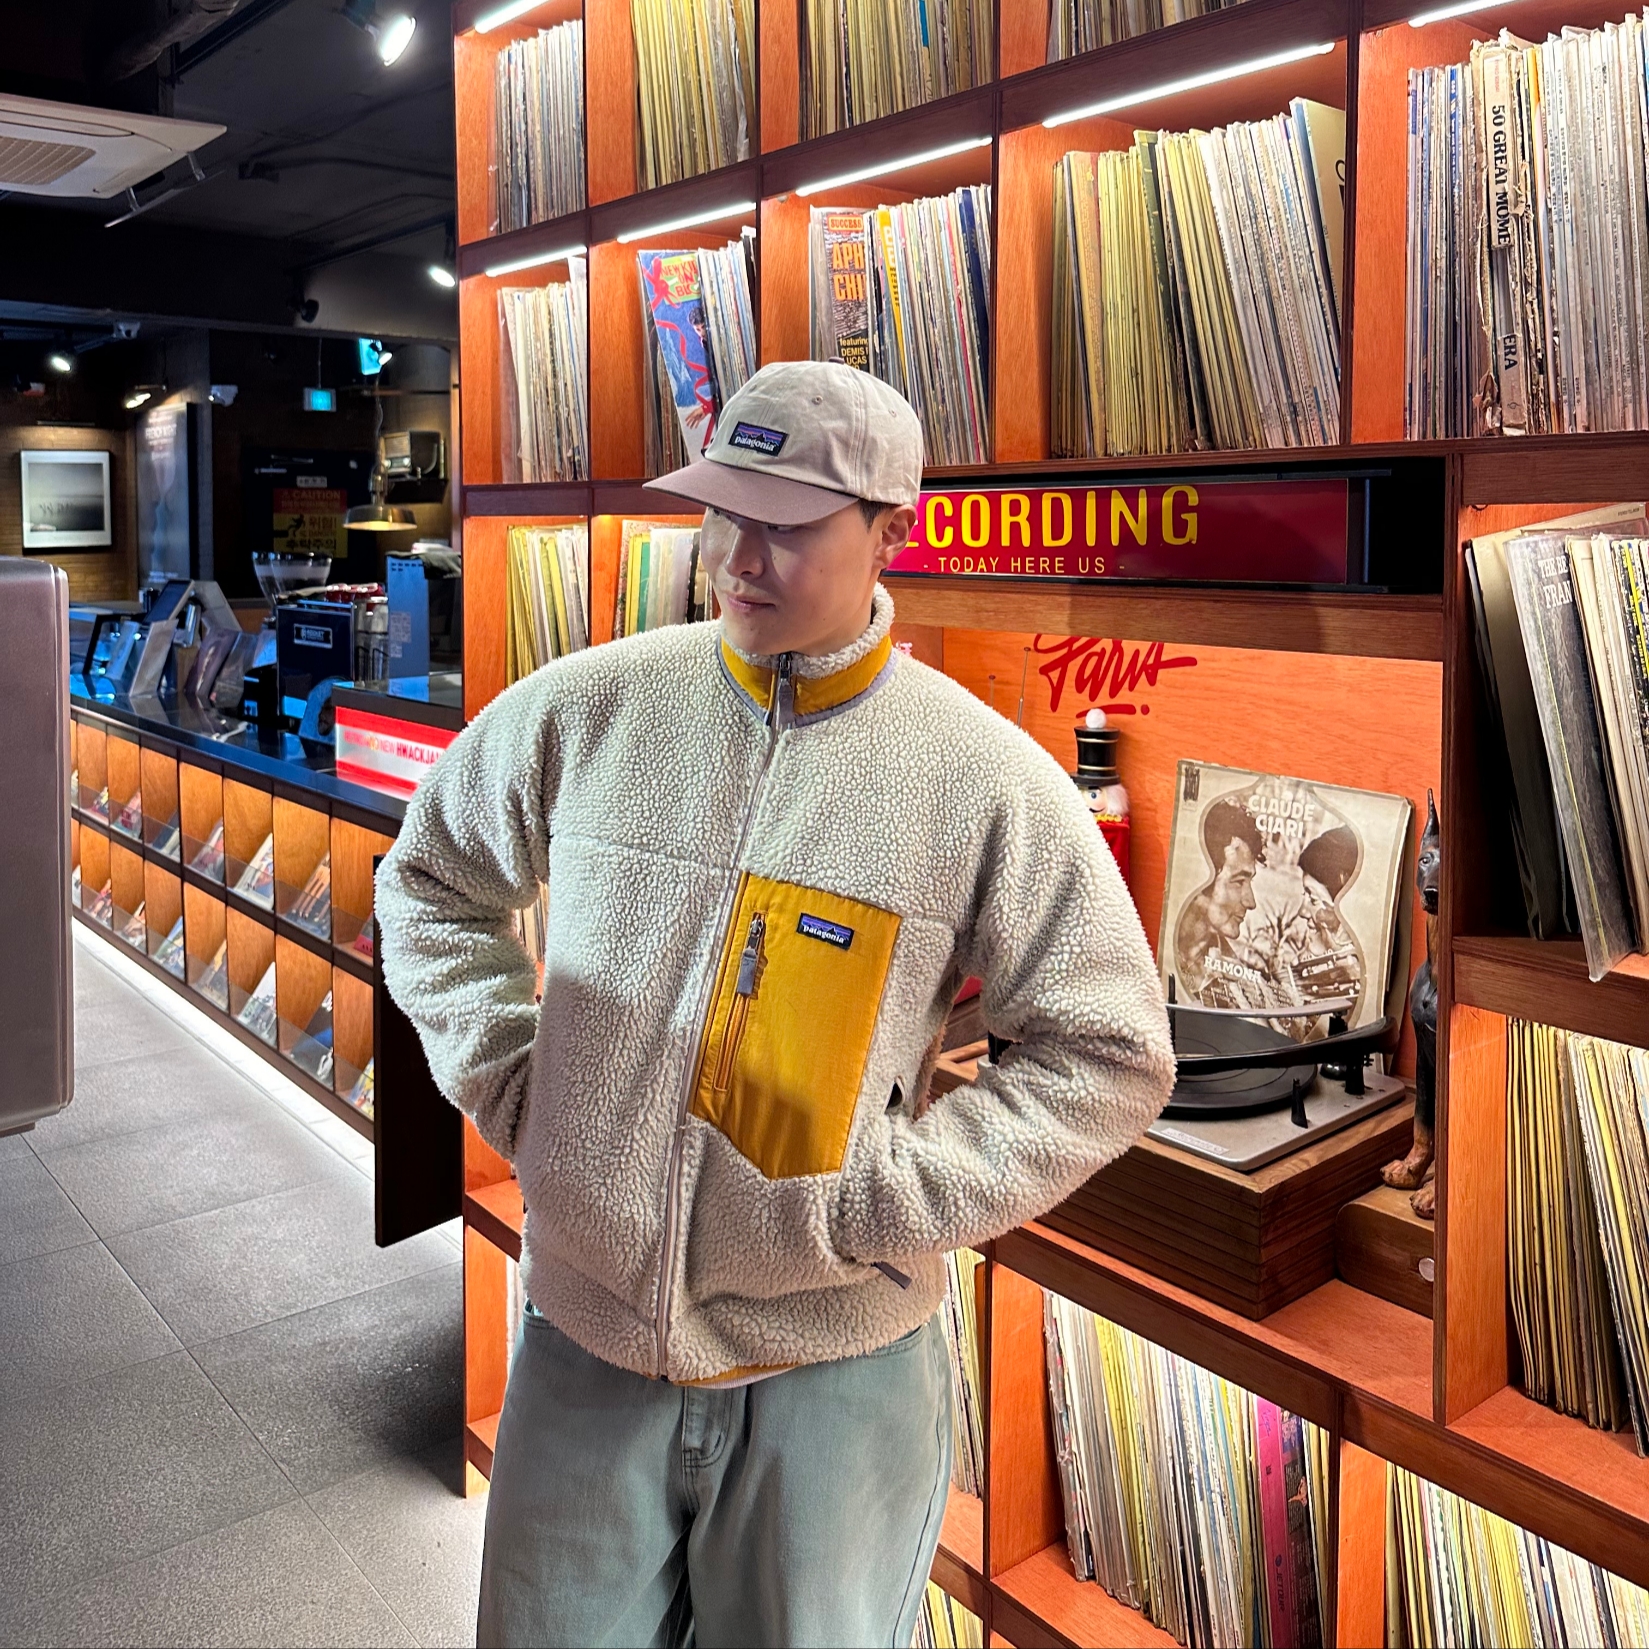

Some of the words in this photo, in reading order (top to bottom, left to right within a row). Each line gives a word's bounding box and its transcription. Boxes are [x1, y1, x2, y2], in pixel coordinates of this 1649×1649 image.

[1492, 105, 1506, 126] 50
[830, 218, 863, 229] SUCCESS
[662, 264, 680, 277] NEW
[841, 347, 865, 357] DEMIS
[845, 356, 868, 365] UCAS
[1503, 334, 1518, 371] ERA
[735, 436, 777, 452] patagonia
[906, 485, 1198, 548] CORDING
[938, 556, 1000, 574] TODAY
[1010, 556, 1065, 573] HERE
[1078, 556, 1106, 574] US
[1538, 558, 1557, 578] THE
[1543, 580, 1573, 609] FRAN
[1249, 794, 1316, 822] CLAUDE
[1255, 815, 1303, 838] CIARI
[803, 925, 845, 944] patagonia
[1204, 955, 1261, 983] RAMONA
